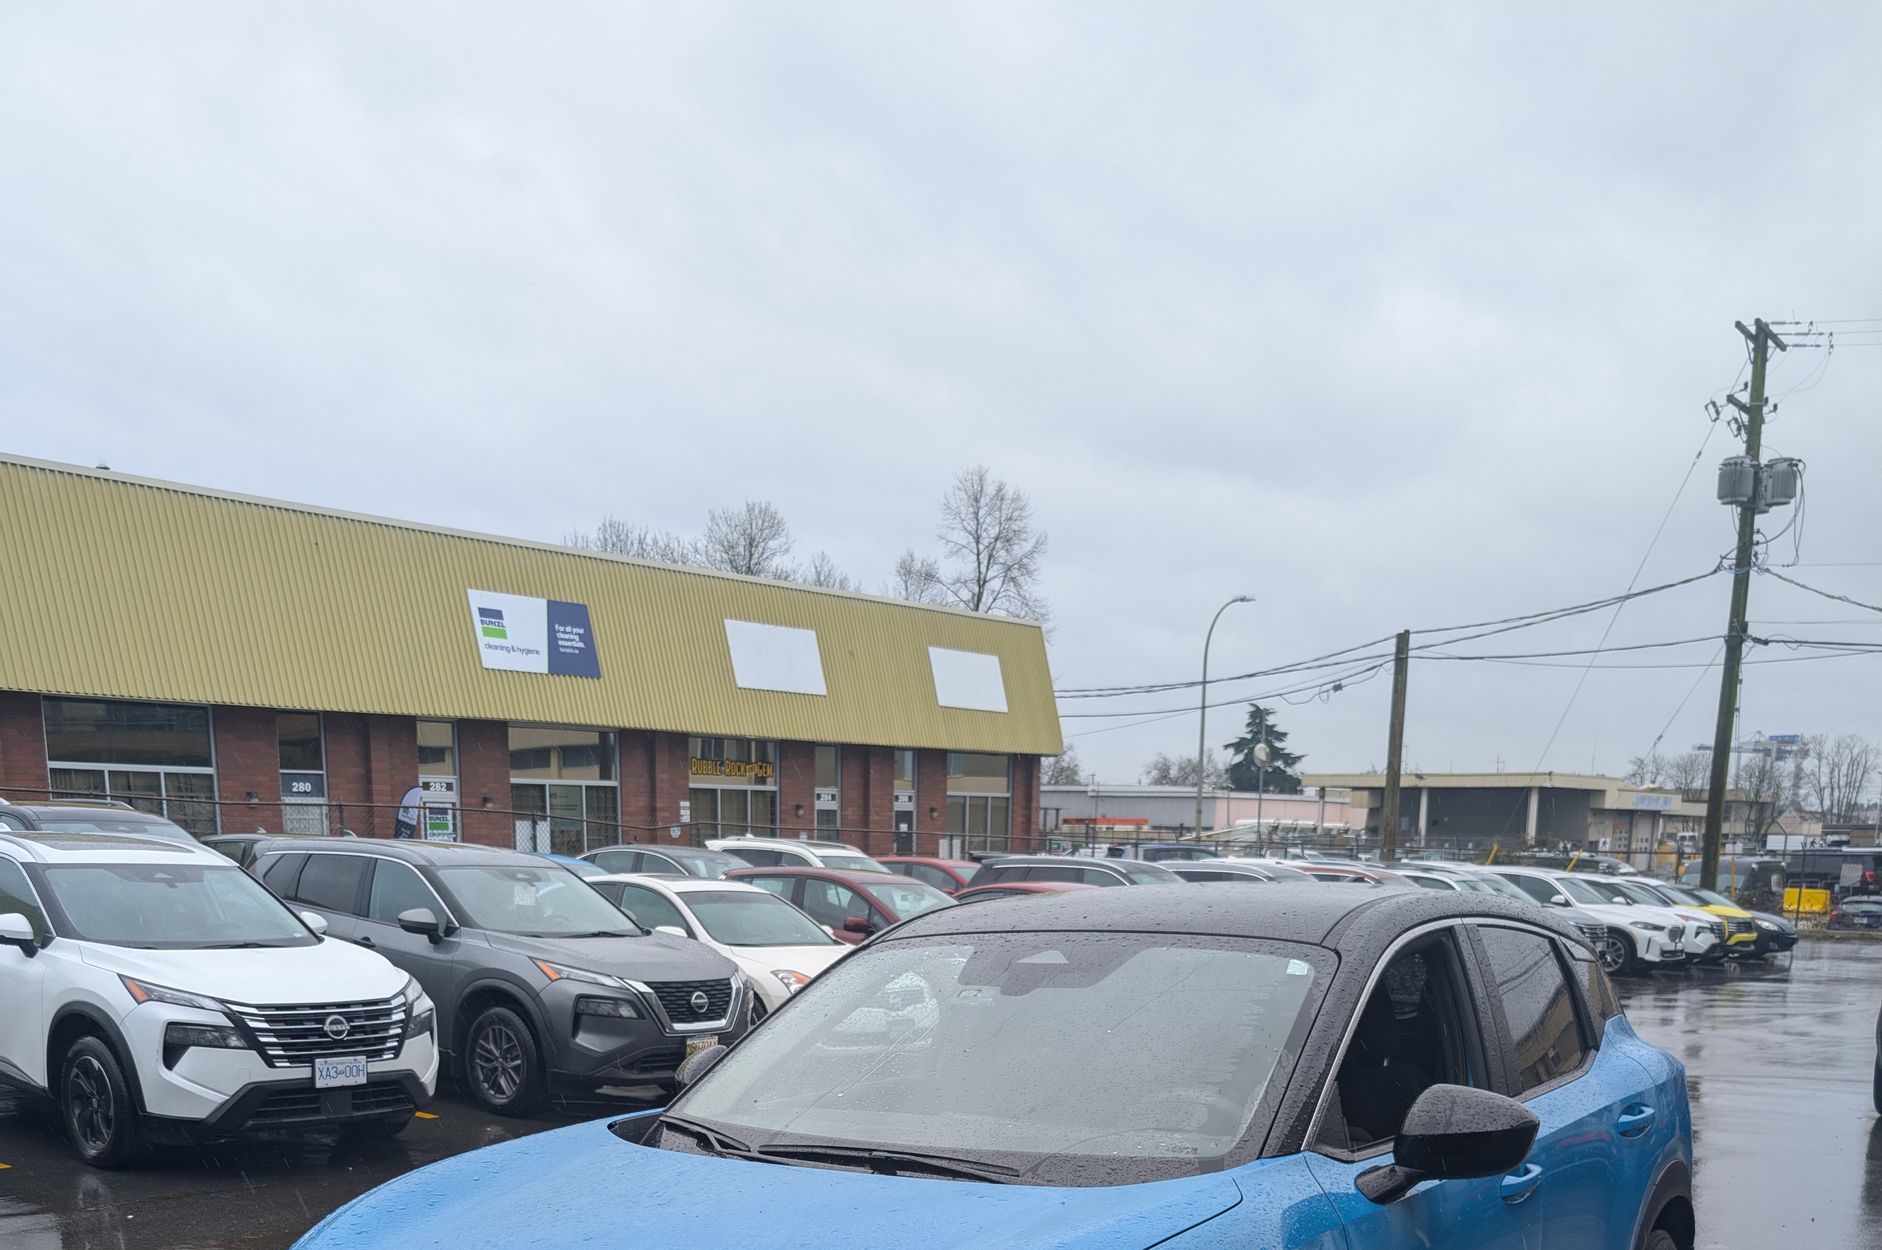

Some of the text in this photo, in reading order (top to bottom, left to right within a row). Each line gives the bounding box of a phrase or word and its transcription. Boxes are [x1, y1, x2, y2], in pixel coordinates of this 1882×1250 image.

[480, 619, 506, 628] BUNZL
[484, 642, 511, 654] cleaning
[516, 645, 541, 656] hygiene
[691, 758, 721, 776] RUBBLE
[725, 760, 746, 777] ROCK
[757, 762, 774, 777] GEM
[291, 781, 312, 793] 280
[429, 782, 447, 792] 282
